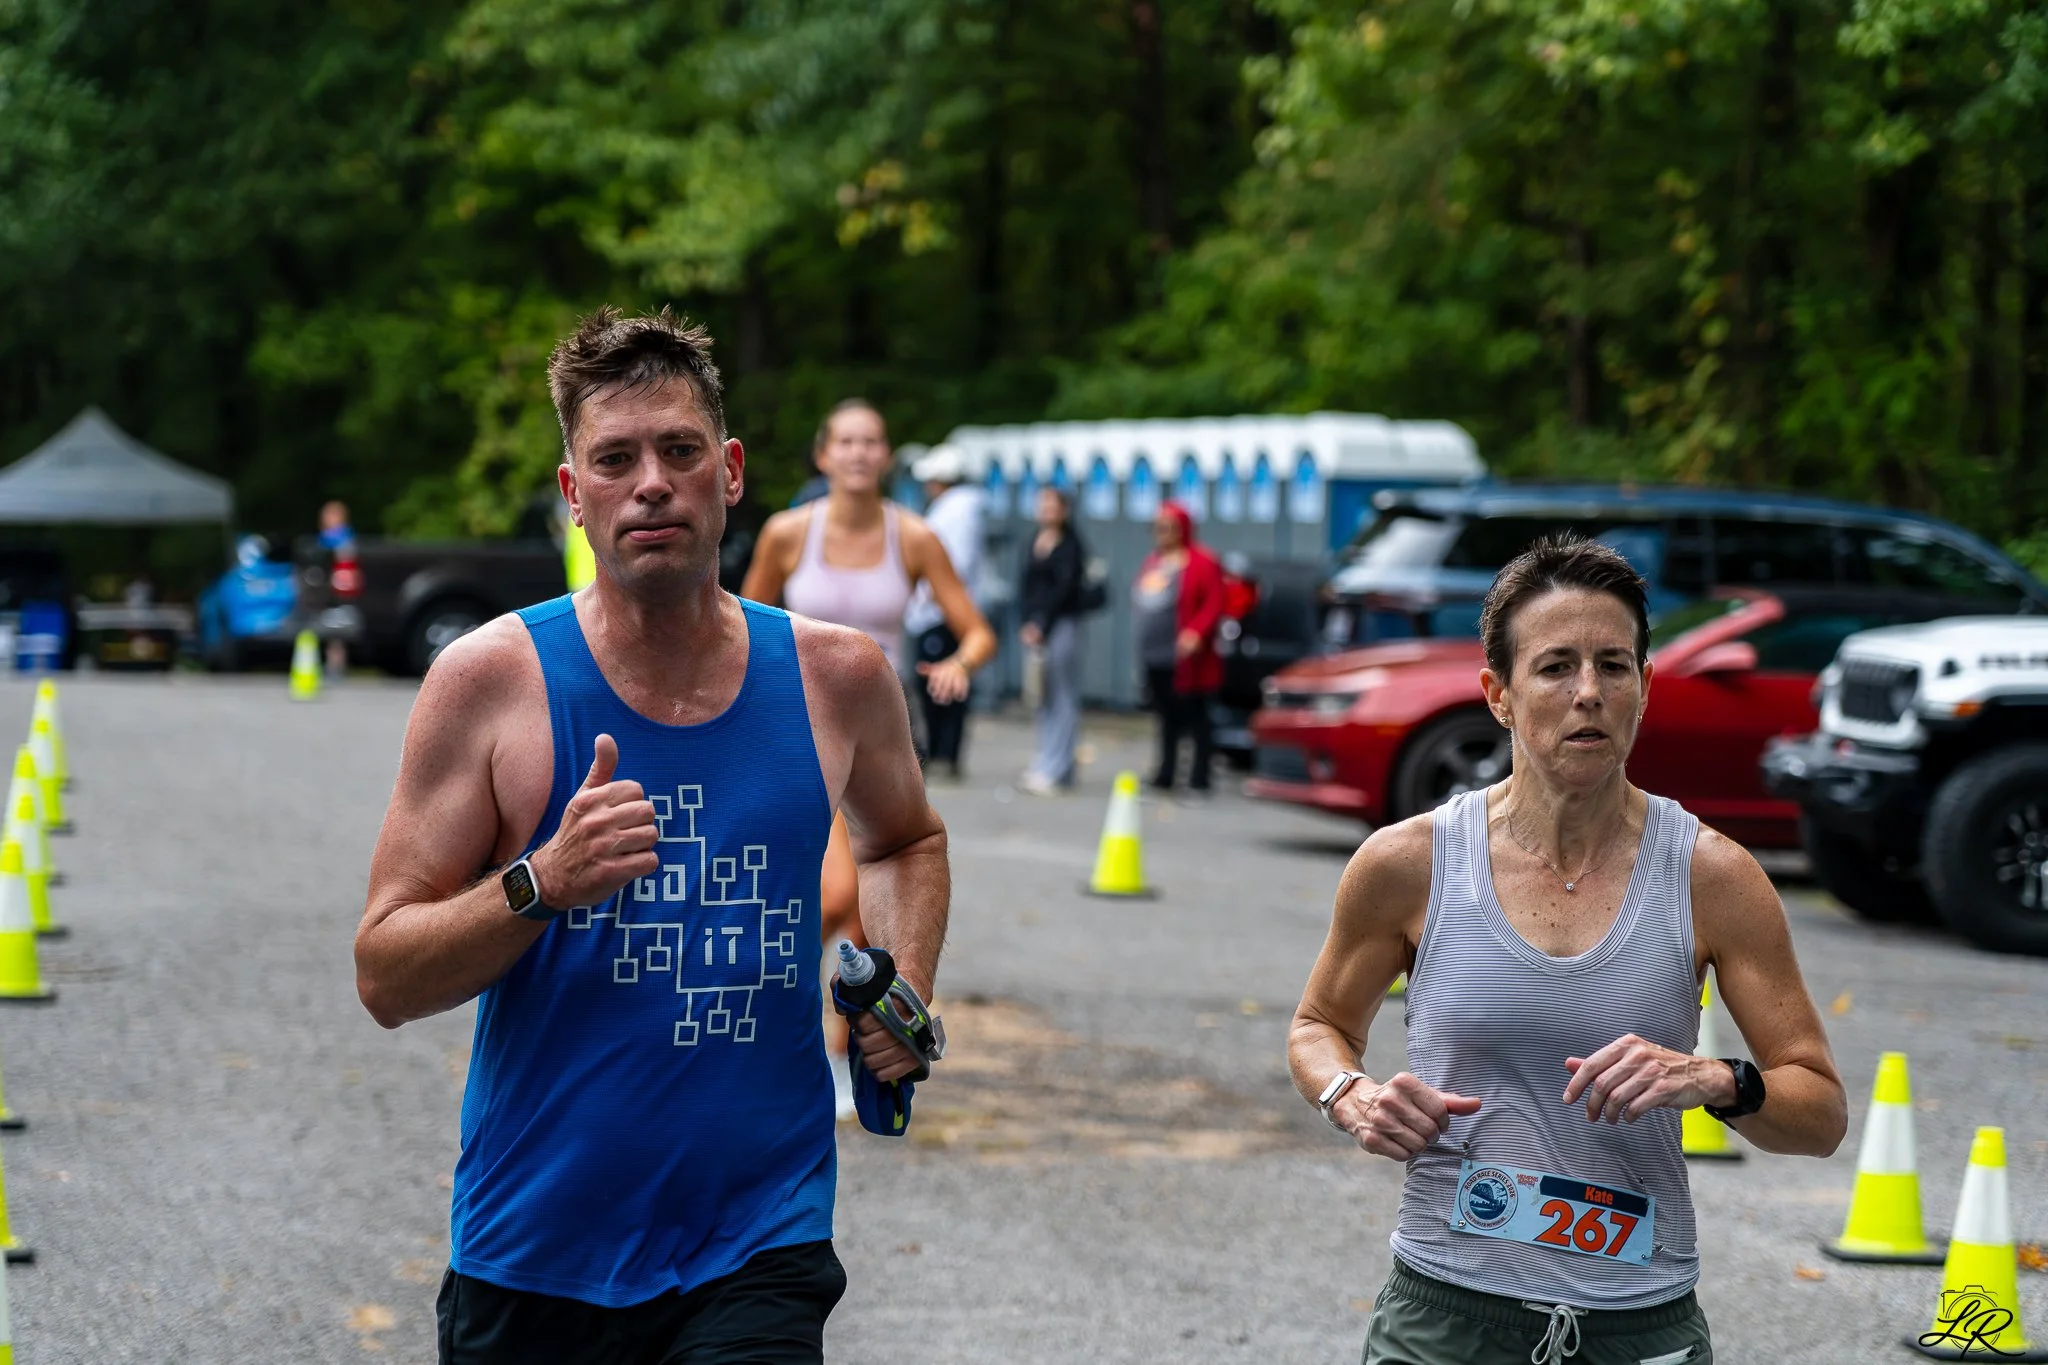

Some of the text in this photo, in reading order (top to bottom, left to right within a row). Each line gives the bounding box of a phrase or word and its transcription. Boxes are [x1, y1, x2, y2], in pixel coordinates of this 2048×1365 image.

[633, 864, 686, 902] GO
[1465, 1177, 1477, 1189] ROAD
[1491, 1171, 1508, 1184] SERIES
[1585, 1186, 1613, 1205] Kate
[1534, 1199, 1639, 1257] 267
